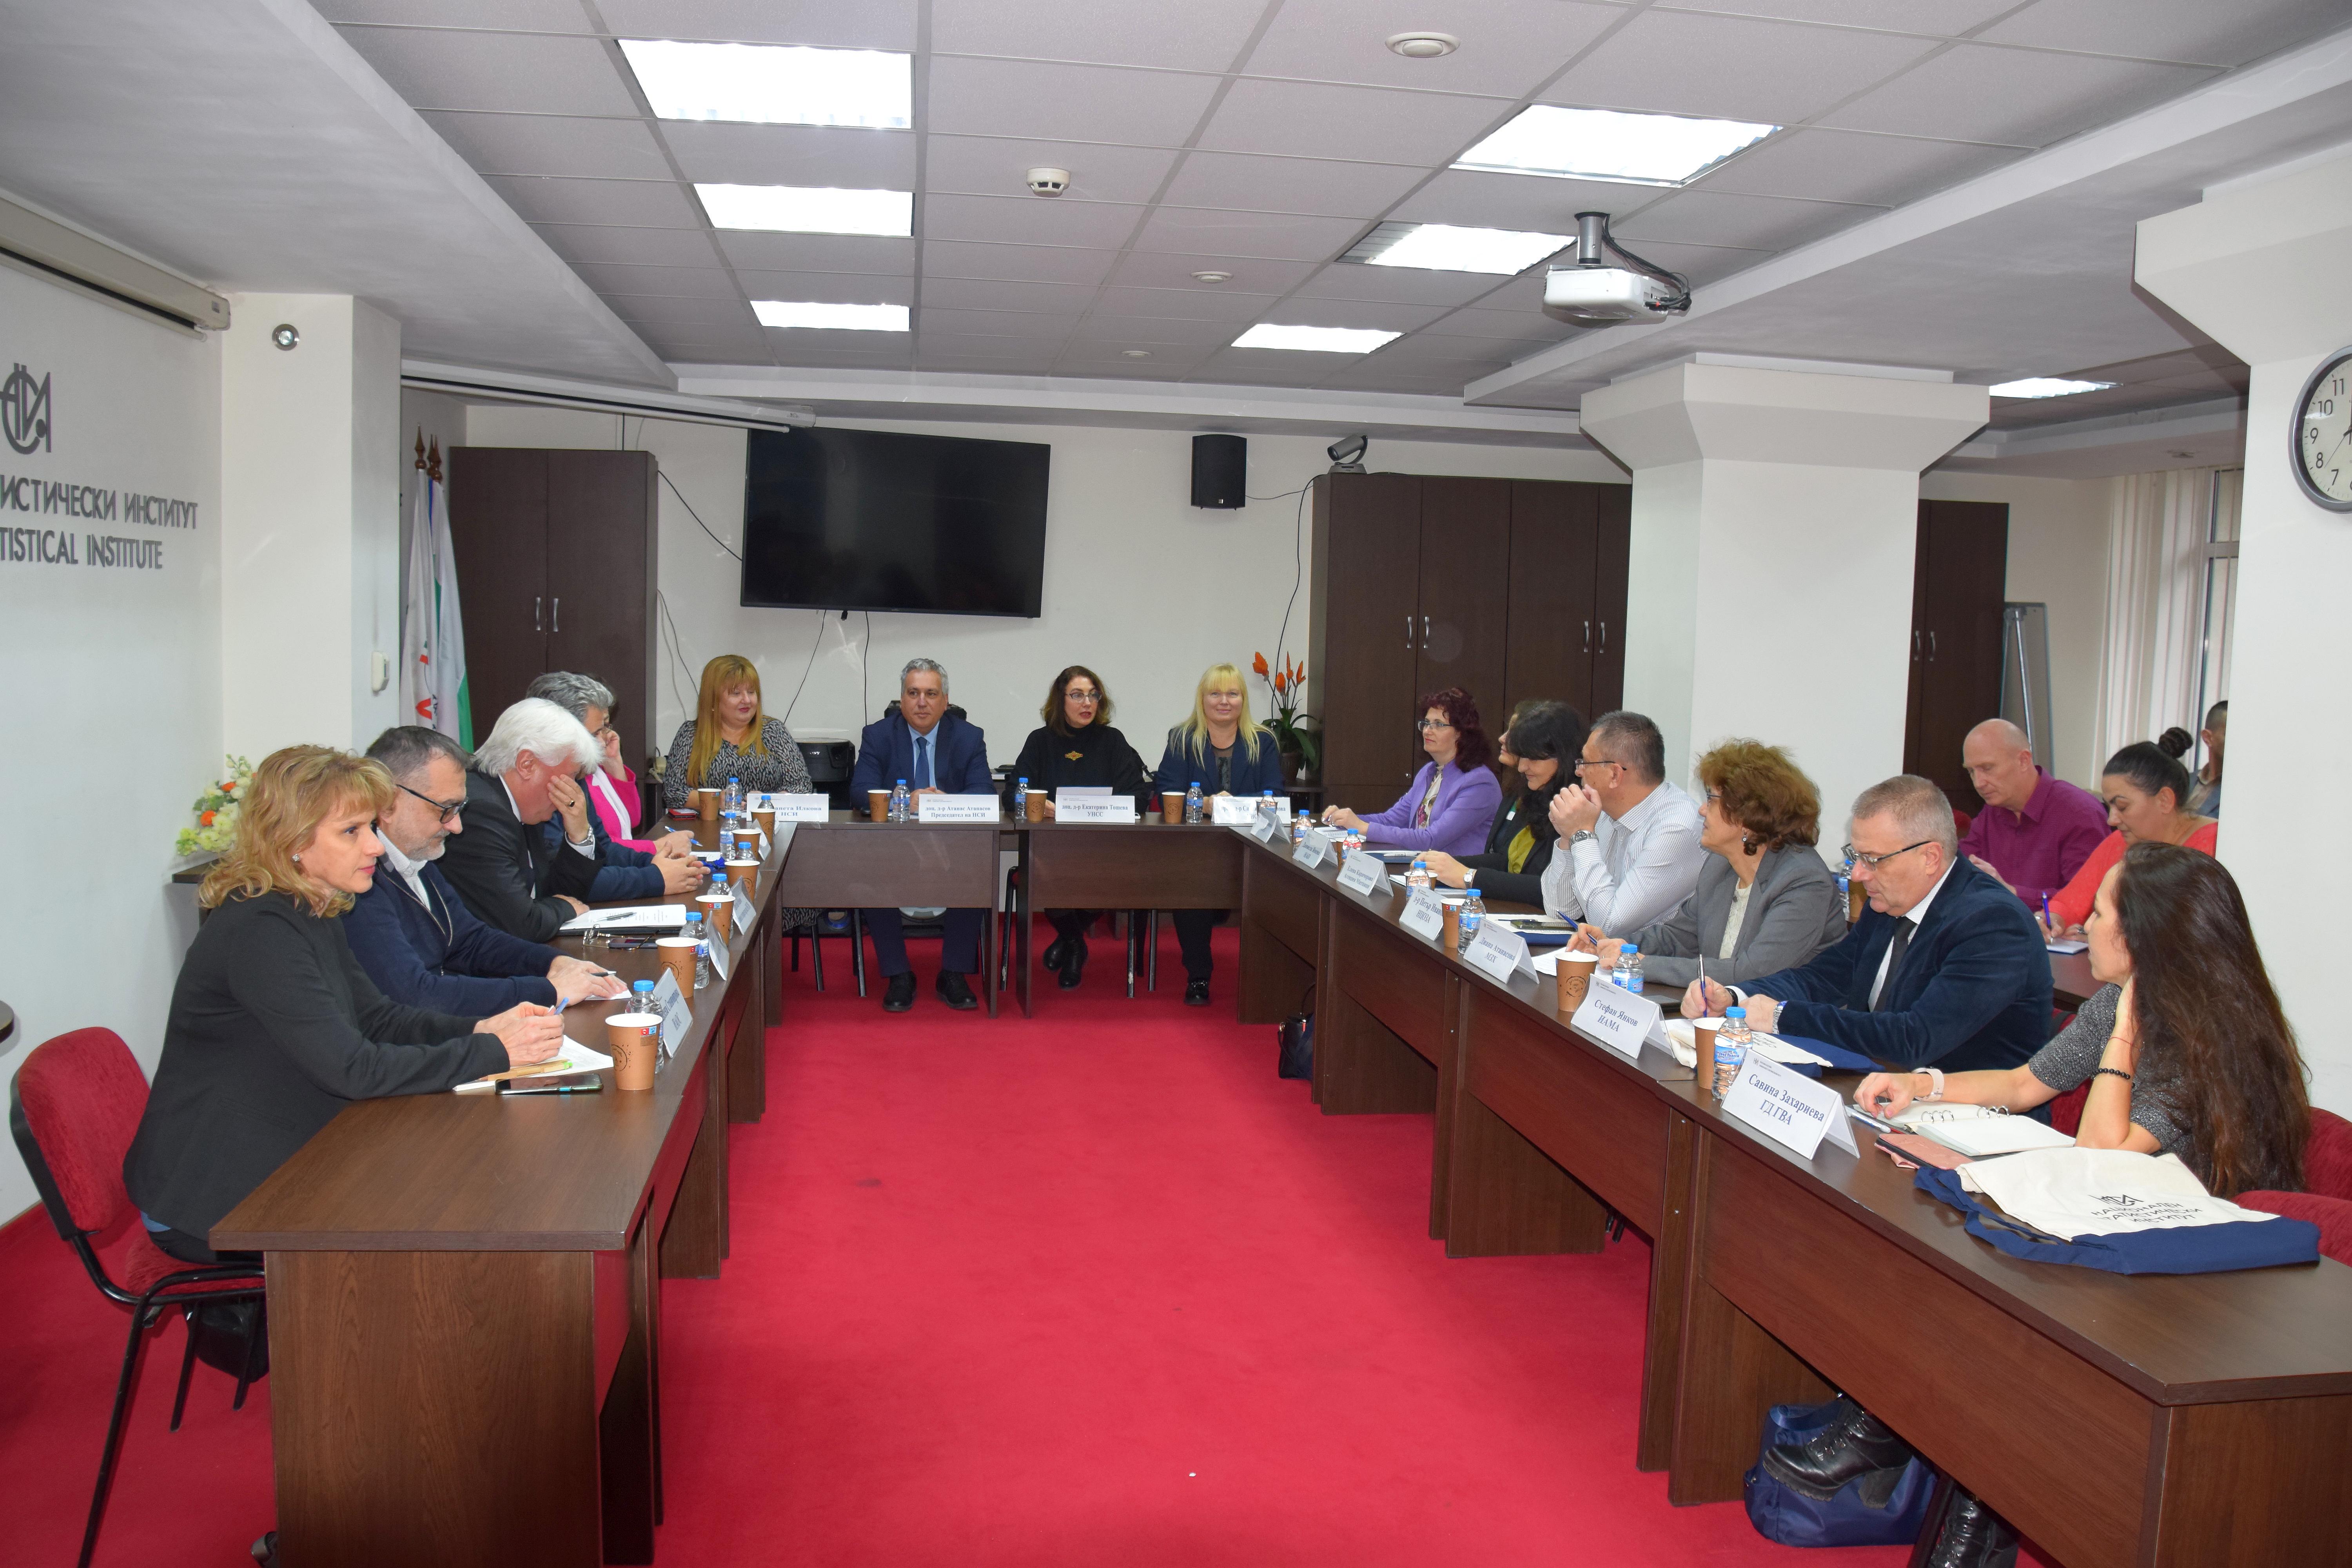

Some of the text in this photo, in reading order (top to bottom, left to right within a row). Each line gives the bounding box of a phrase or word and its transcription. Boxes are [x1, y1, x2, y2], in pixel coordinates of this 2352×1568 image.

[2332, 379, 2344, 396] 11
[2318, 399, 2333, 417] 10
[2310, 428, 2318, 444] 9
[2316, 452, 2323, 468] 8
[2331, 469, 2339, 486] 7
[124, 493, 197, 529] ИНСТИТУТ
[87, 534, 162, 569] INSTITUTE
[1420, 898, 1431, 909] Петър
[1416, 910, 1431, 923] НЦОЗА
[1479, 937, 1515, 960] Диана Атанасова
[1485, 952, 1498, 963] МЗХ
[1595, 1000, 1638, 1026] Стефан Янков
[1597, 1015, 1620, 1032] ИАМА
[1749, 1074, 1824, 1122] Савина Захариева
[1759, 1100, 1792, 1125] ГД ГВА
[2091, 1203, 2183, 1215] НАЦИОНАЛЕН
